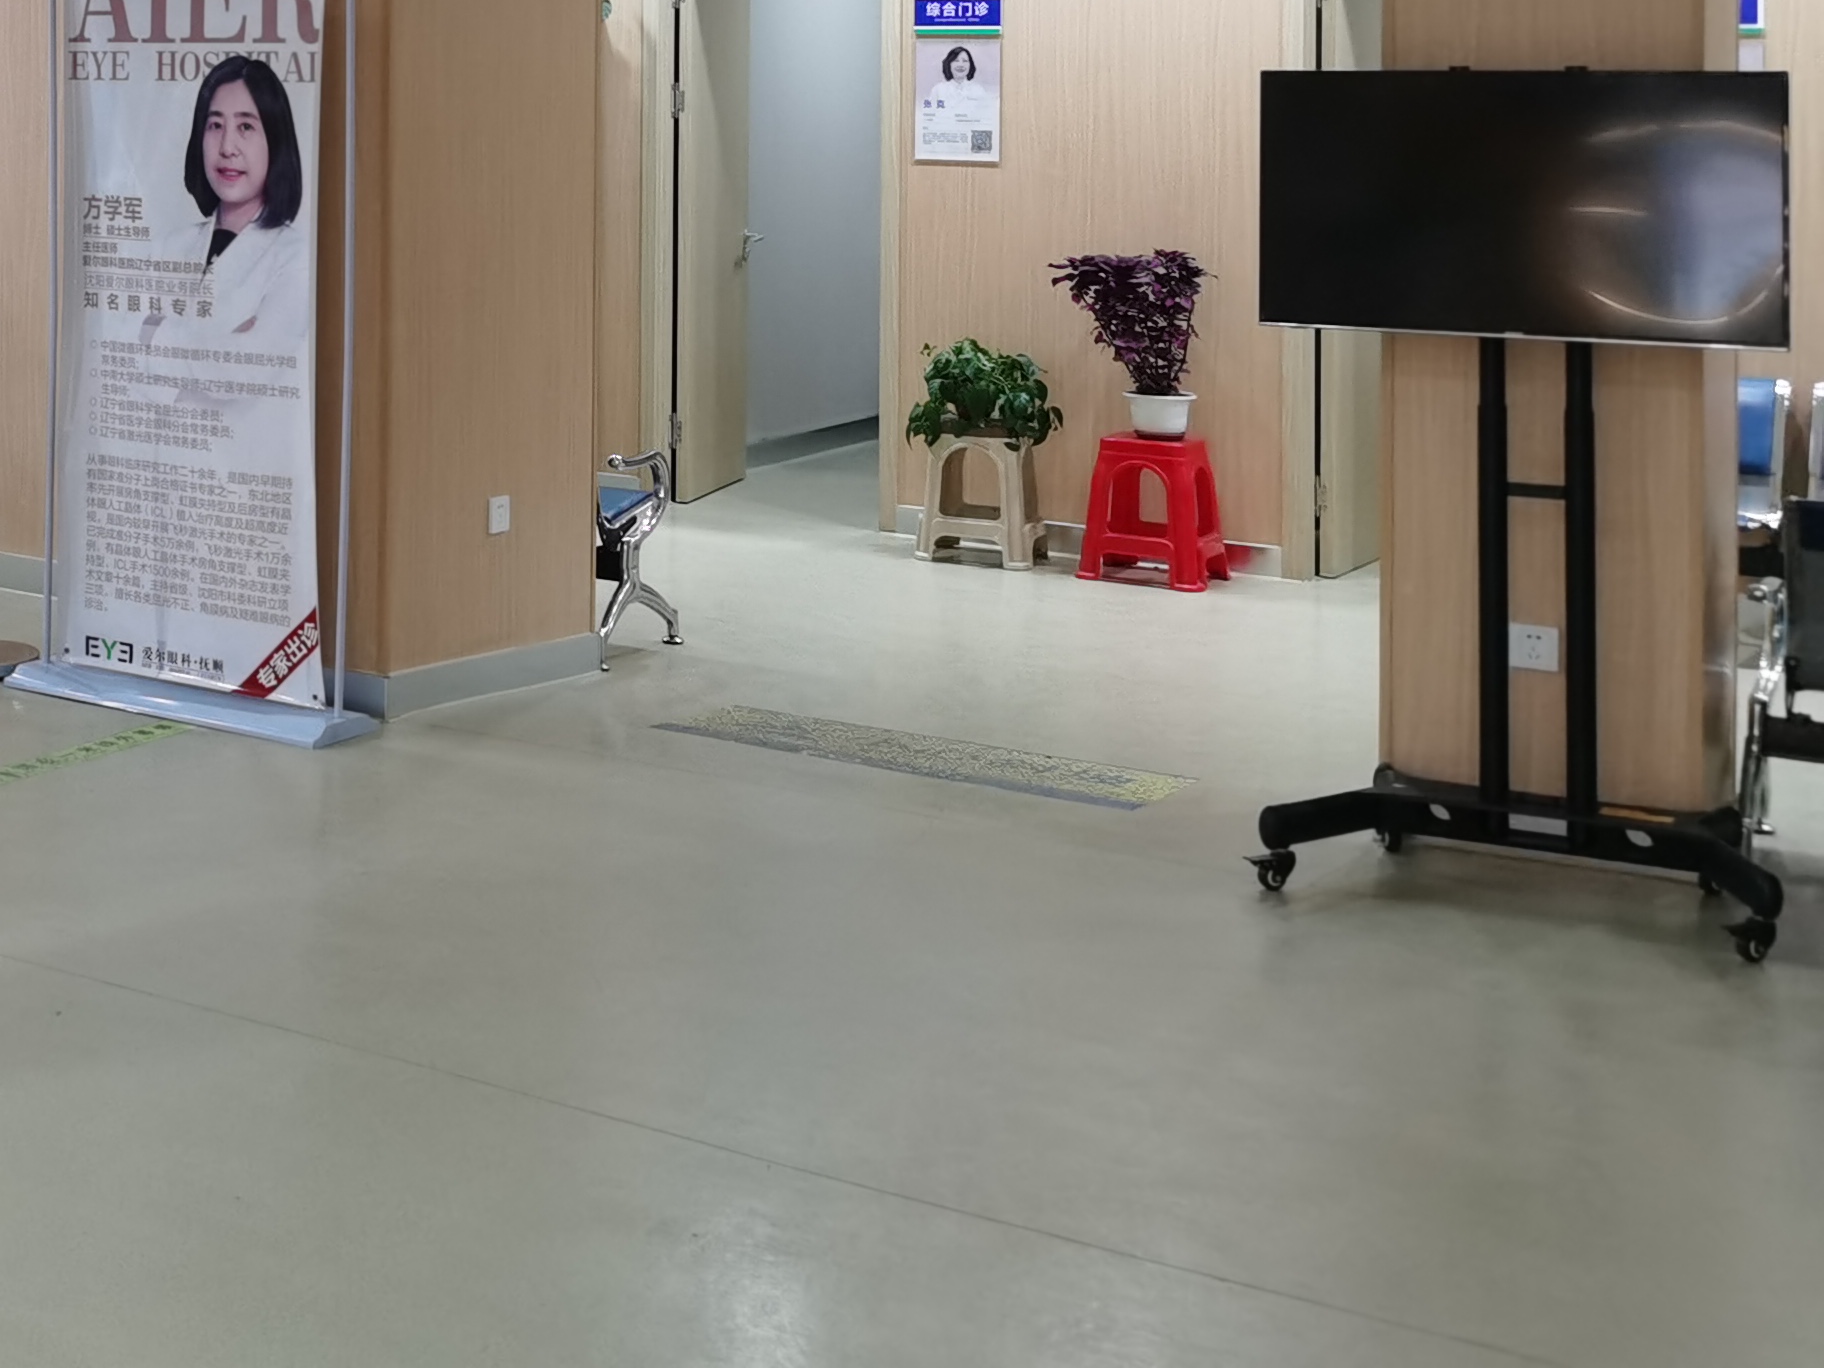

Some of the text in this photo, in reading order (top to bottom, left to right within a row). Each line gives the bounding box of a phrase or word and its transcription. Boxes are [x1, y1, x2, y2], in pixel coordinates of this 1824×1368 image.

[926, 2, 989, 17] 综合门诊
[68, 50, 319, 83] EYE HOSTA
[83, 194, 143, 223] 方学军
[84, 291, 213, 318] 知名眼科专家
[257, 621, 319, 690] 专家出诊
